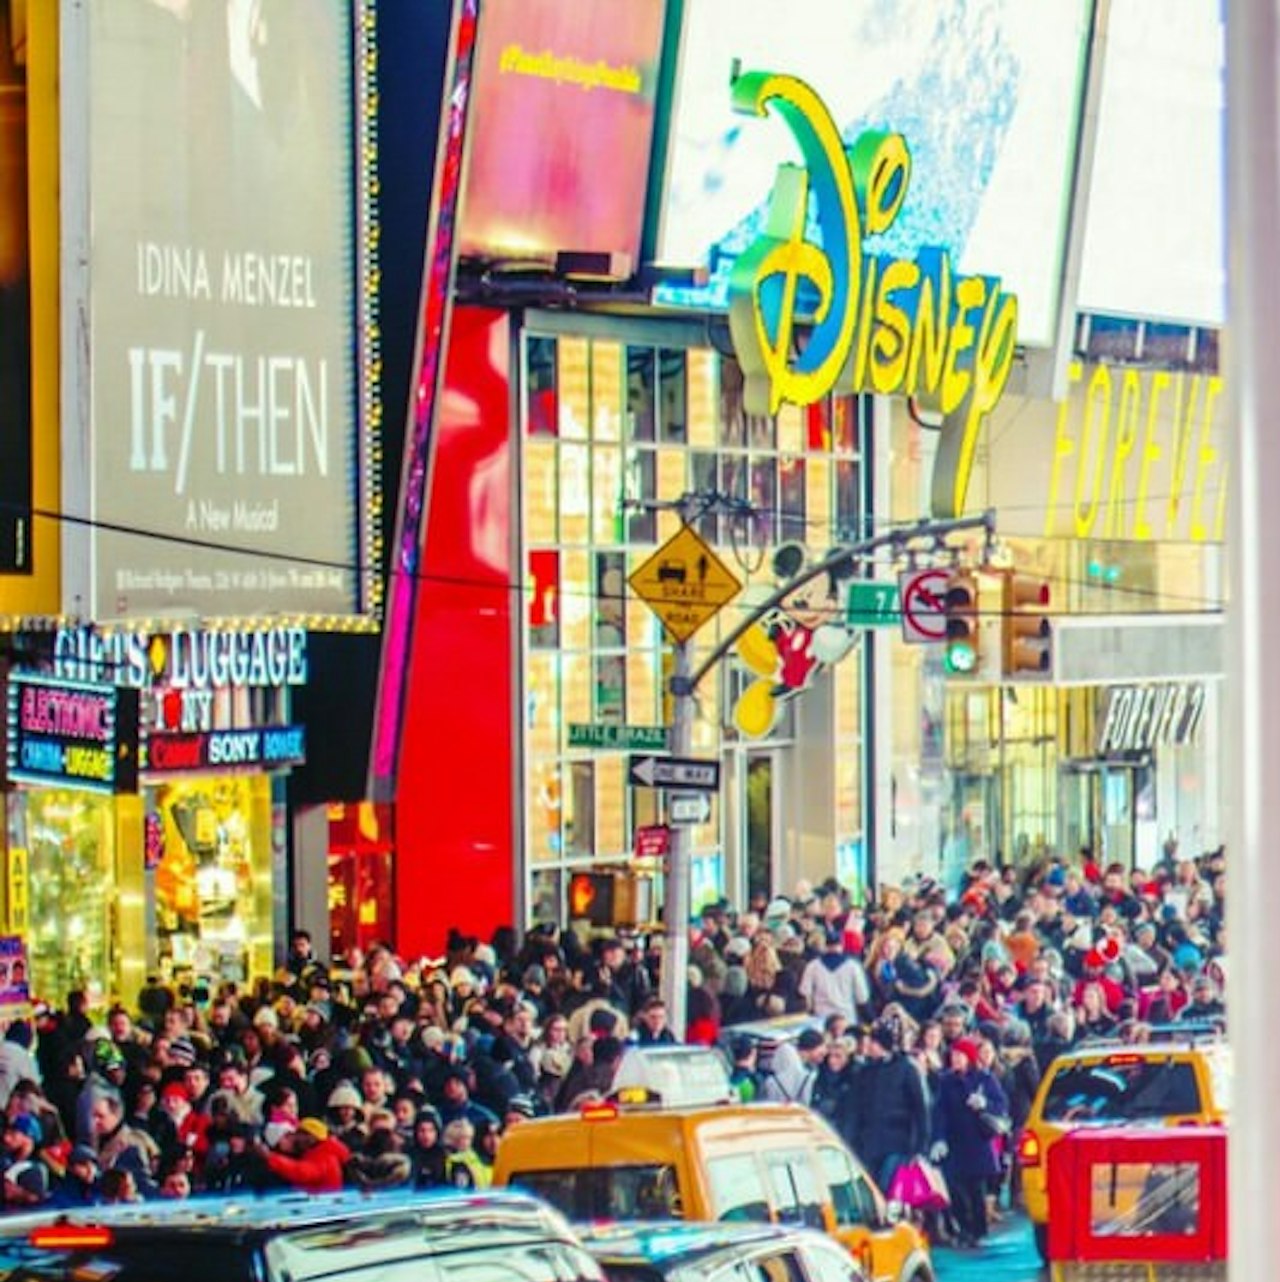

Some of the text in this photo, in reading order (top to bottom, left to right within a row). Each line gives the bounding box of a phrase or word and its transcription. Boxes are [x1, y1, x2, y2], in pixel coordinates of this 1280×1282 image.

[137, 242, 317, 308] IDINA MENZEL
[127, 330, 328, 495] IF/THEN
[1046, 361, 1228, 541] FOREVE
[185, 499, 279, 533] A New Musical
[171, 627, 307, 688] LUGGAGE
[180, 689, 212, 733] NY
[209, 733, 258, 763] SONY
